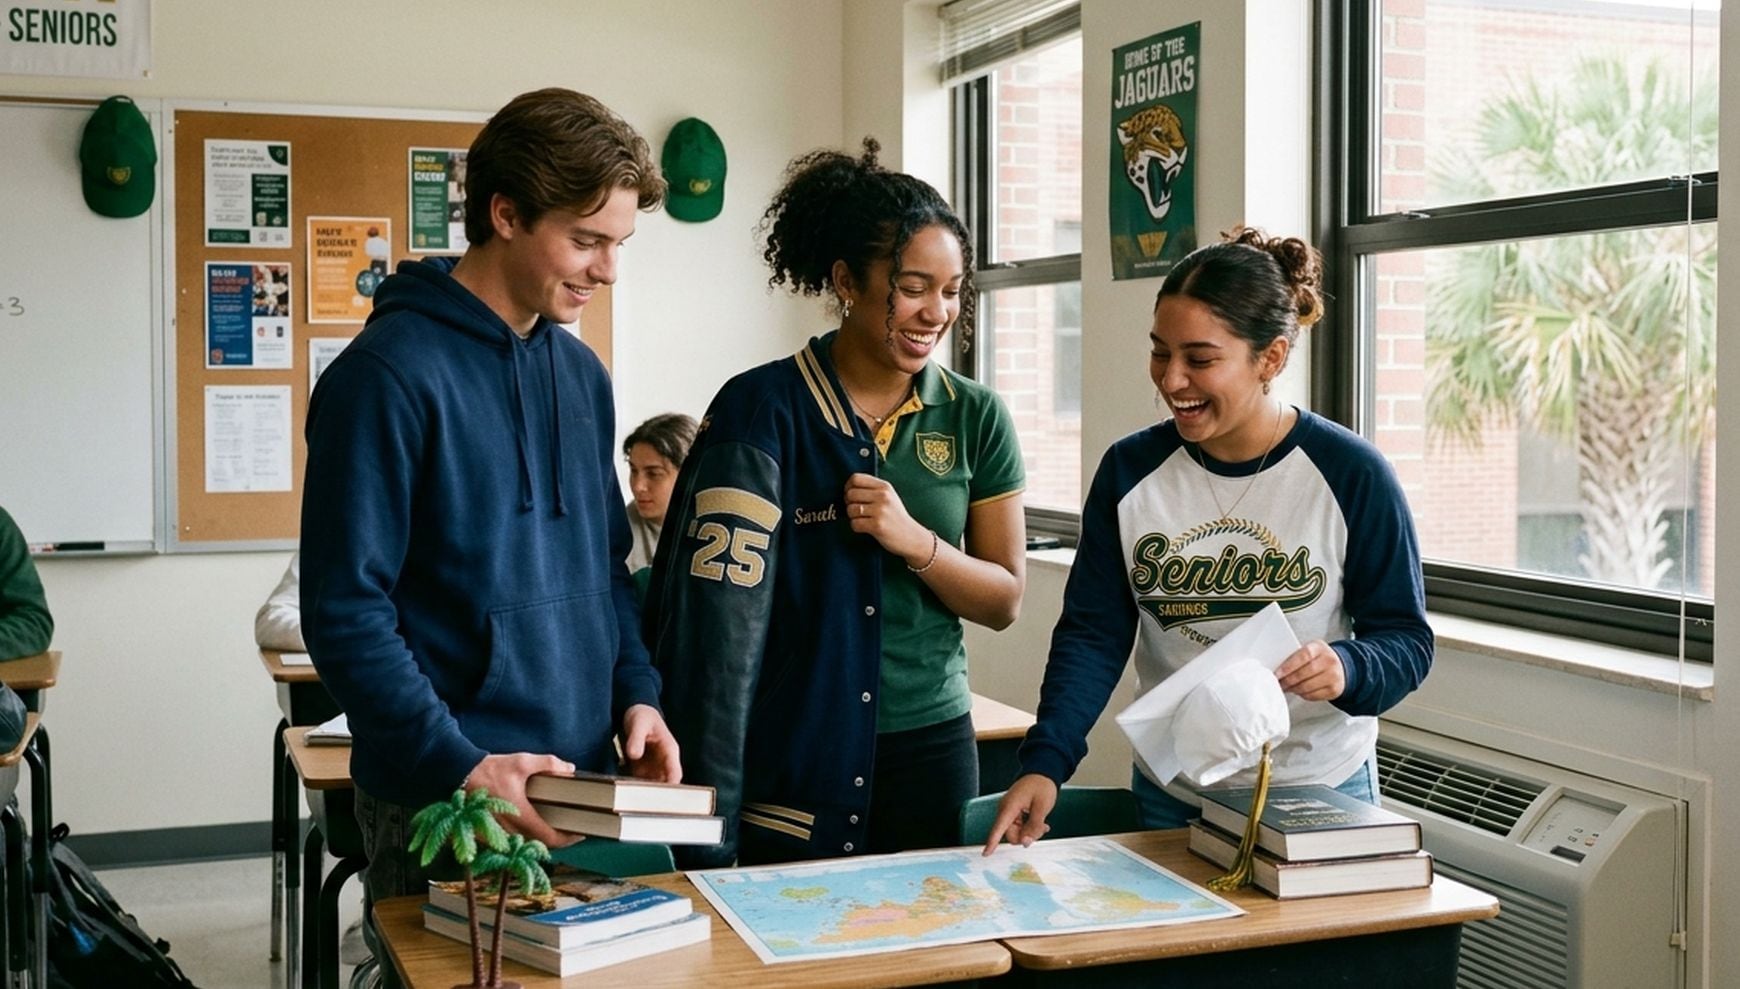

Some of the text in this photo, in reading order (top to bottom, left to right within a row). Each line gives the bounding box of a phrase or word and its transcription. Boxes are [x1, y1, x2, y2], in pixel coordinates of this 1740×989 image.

[8, 7, 117, 47] SENIORS
[1114, 55, 1195, 109] JAGUARS
[1131, 532, 1326, 595] Seniors
